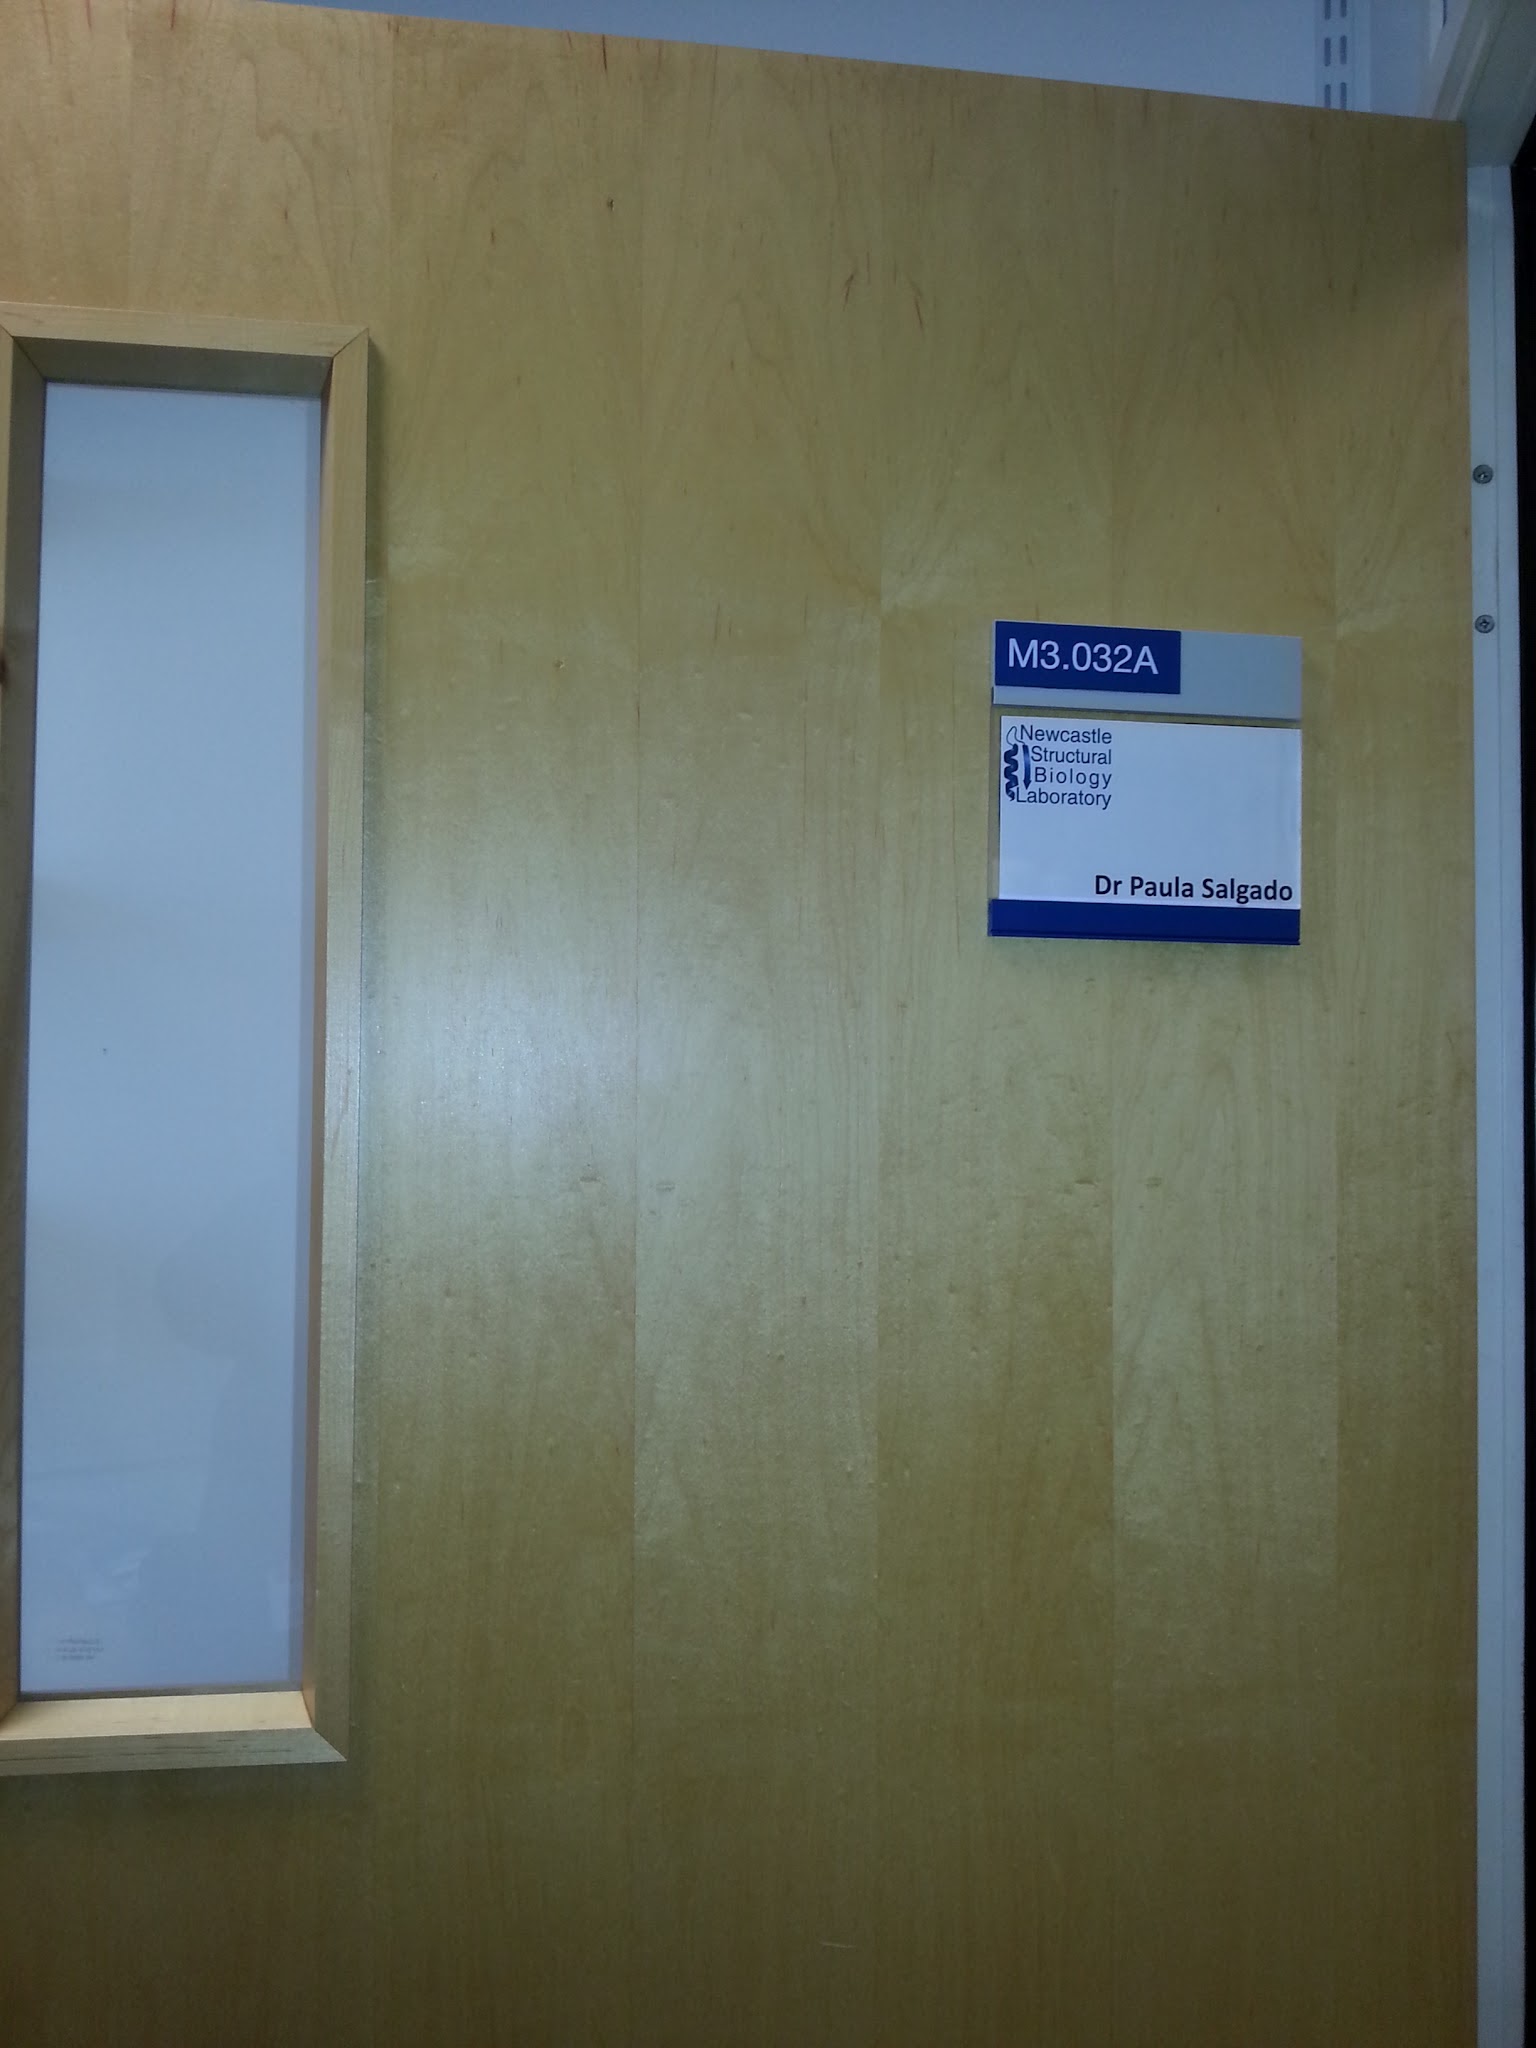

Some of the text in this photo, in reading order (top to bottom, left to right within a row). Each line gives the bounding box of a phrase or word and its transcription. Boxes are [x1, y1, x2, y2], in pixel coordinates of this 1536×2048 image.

[1008, 638, 1158, 675] M3.032A
[1020, 724, 1112, 744] Newcastle
[1031, 746, 1112, 765] Structural
[1034, 766, 1112, 789] Biology
[1016, 787, 1112, 810] Laboratory
[1095, 874, 1293, 904] Dr Paula Salgado
